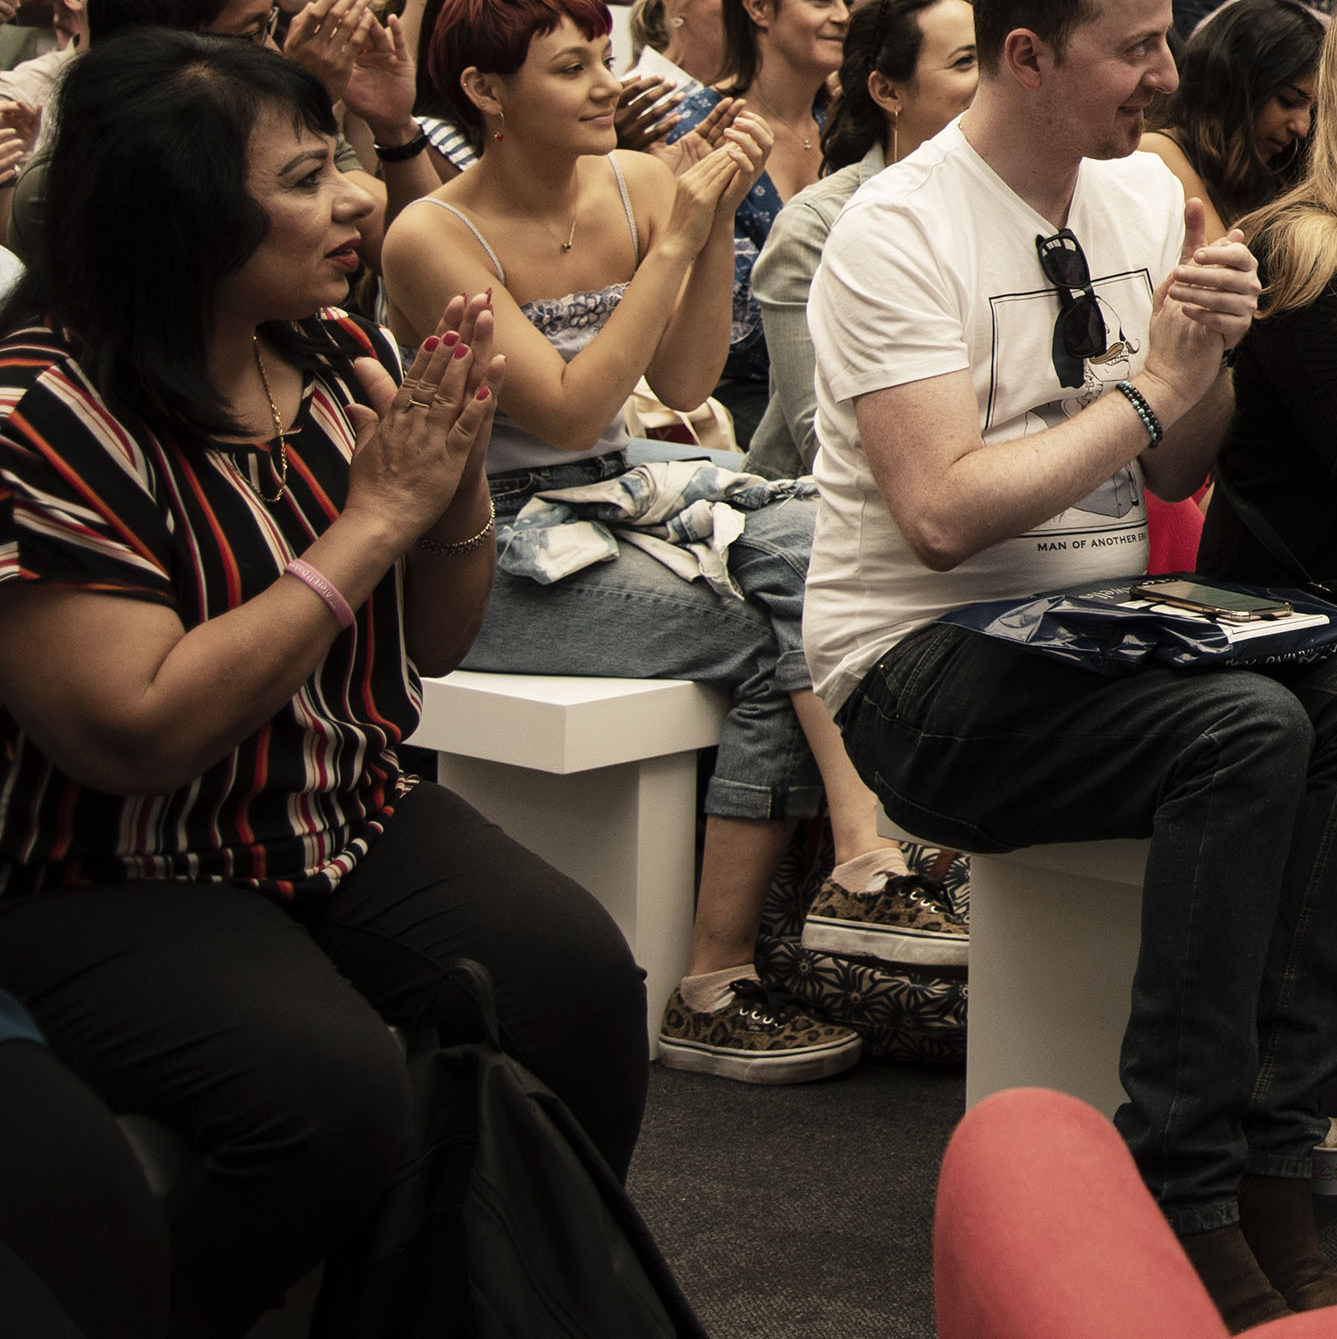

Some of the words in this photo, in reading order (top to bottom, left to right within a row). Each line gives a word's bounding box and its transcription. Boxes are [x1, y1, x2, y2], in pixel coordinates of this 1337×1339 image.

[1037, 542, 1067, 552] MAN
[1072, 540, 1087, 549] OF
[1091, 535, 1137, 548] ANOTHER
